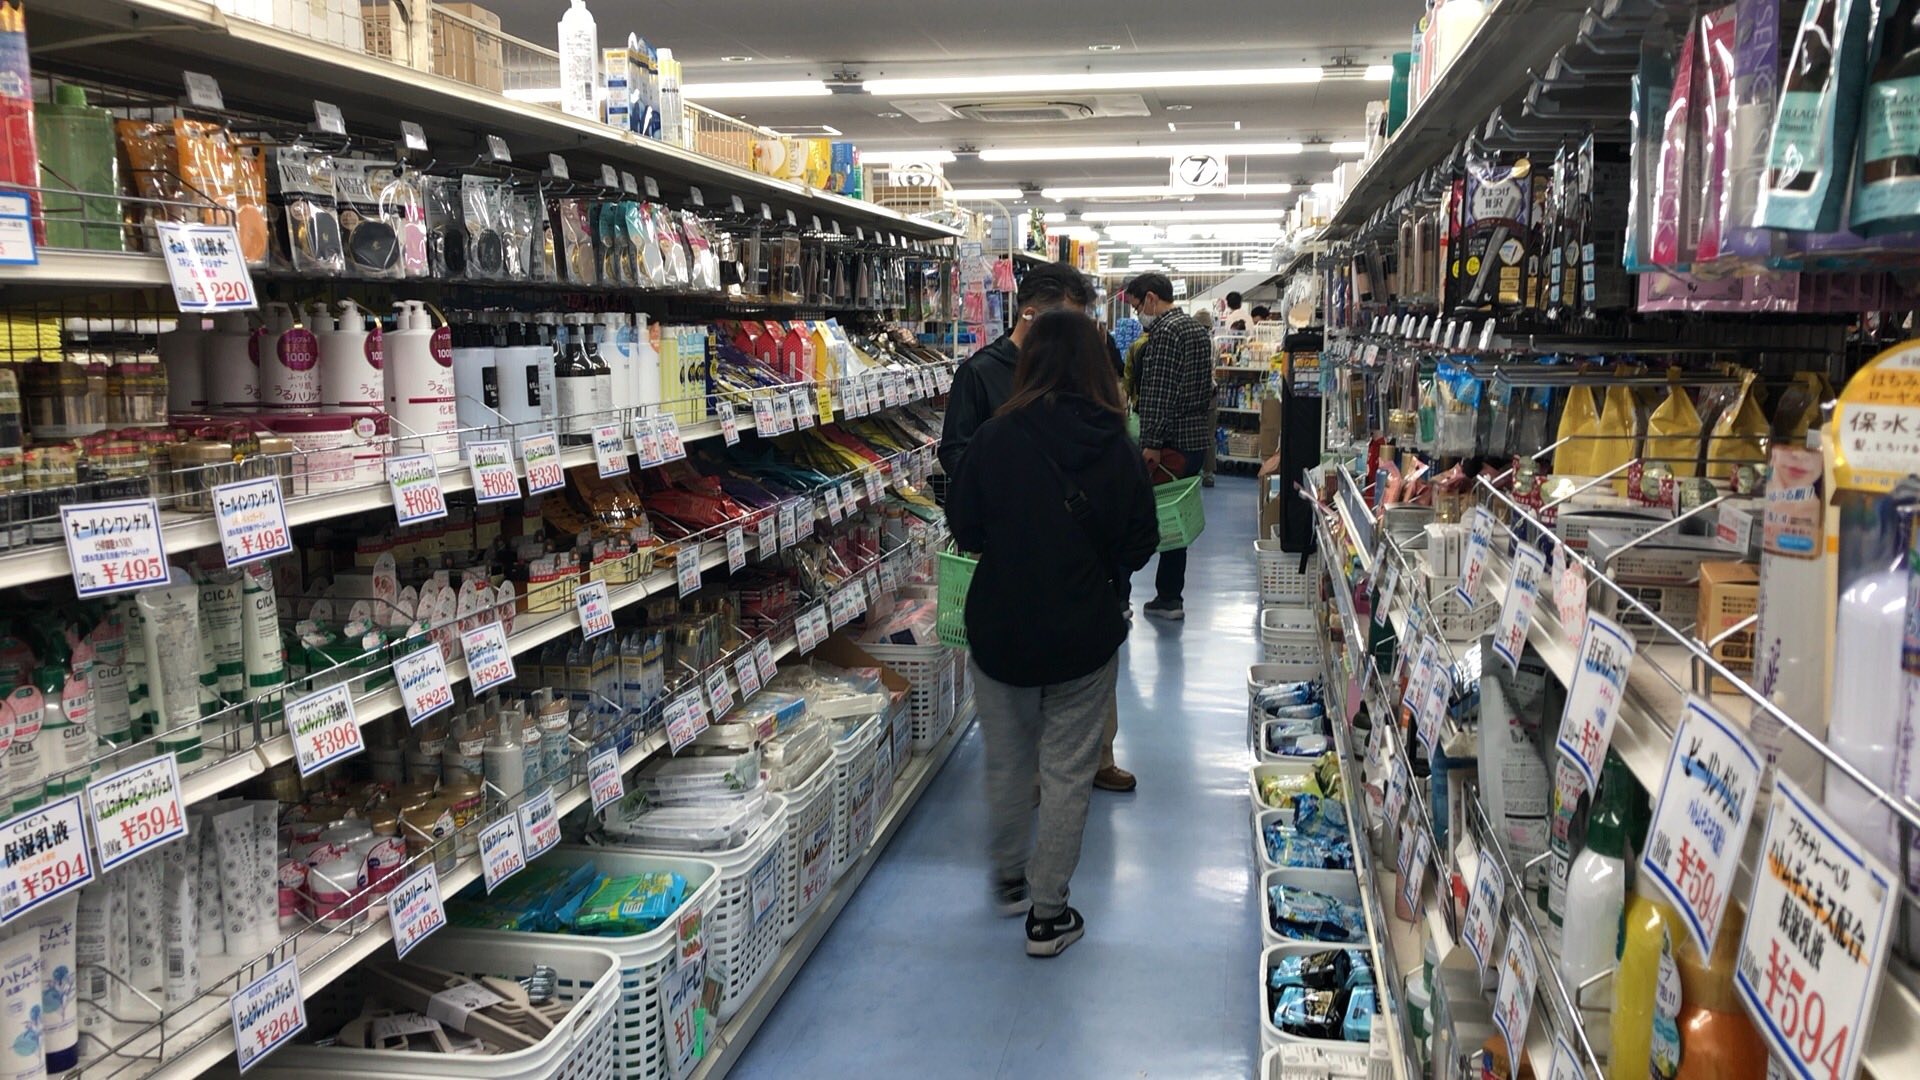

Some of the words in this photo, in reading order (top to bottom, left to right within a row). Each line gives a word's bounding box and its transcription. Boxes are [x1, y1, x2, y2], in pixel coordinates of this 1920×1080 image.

[1190, 155, 1209, 182] 7
[193, 280, 249, 302] ¥220
[286, 352, 311, 363] 1000
[1850, 411, 1920, 438] 保水
[480, 470, 516, 496] ¥693
[527, 462, 563, 491] ¥330
[217, 487, 276, 516] オールインワンゲル
[402, 485, 442, 517] ¥693
[69, 511, 152, 539] オールインワンゲル
[239, 526, 286, 556] ¥495
[100, 555, 162, 586] ¥495
[204, 588, 234, 602] CICA
[256, 594, 274, 610] CICA
[475, 658, 510, 688] ¥825
[415, 683, 449, 715] ¥825
[311, 719, 359, 761] ¥396
[12, 812, 49, 835] CICA
[119, 796, 182, 850] ¥594
[1, 817, 71, 869] 保湿乳液
[1788, 816, 1851, 892] プラチナレーベル
[20, 850, 86, 903] ¥594
[492, 851, 520, 882] ¥495
[1675, 836, 1723, 941] ¥594
[1768, 838, 1867, 963] ハトムギエキス配合
[406, 905, 440, 944] ¥495
[1778, 892, 1827, 974] 保湿乳液
[1764, 936, 1849, 1080] ¥594
[255, 1002, 300, 1052] ¥264
